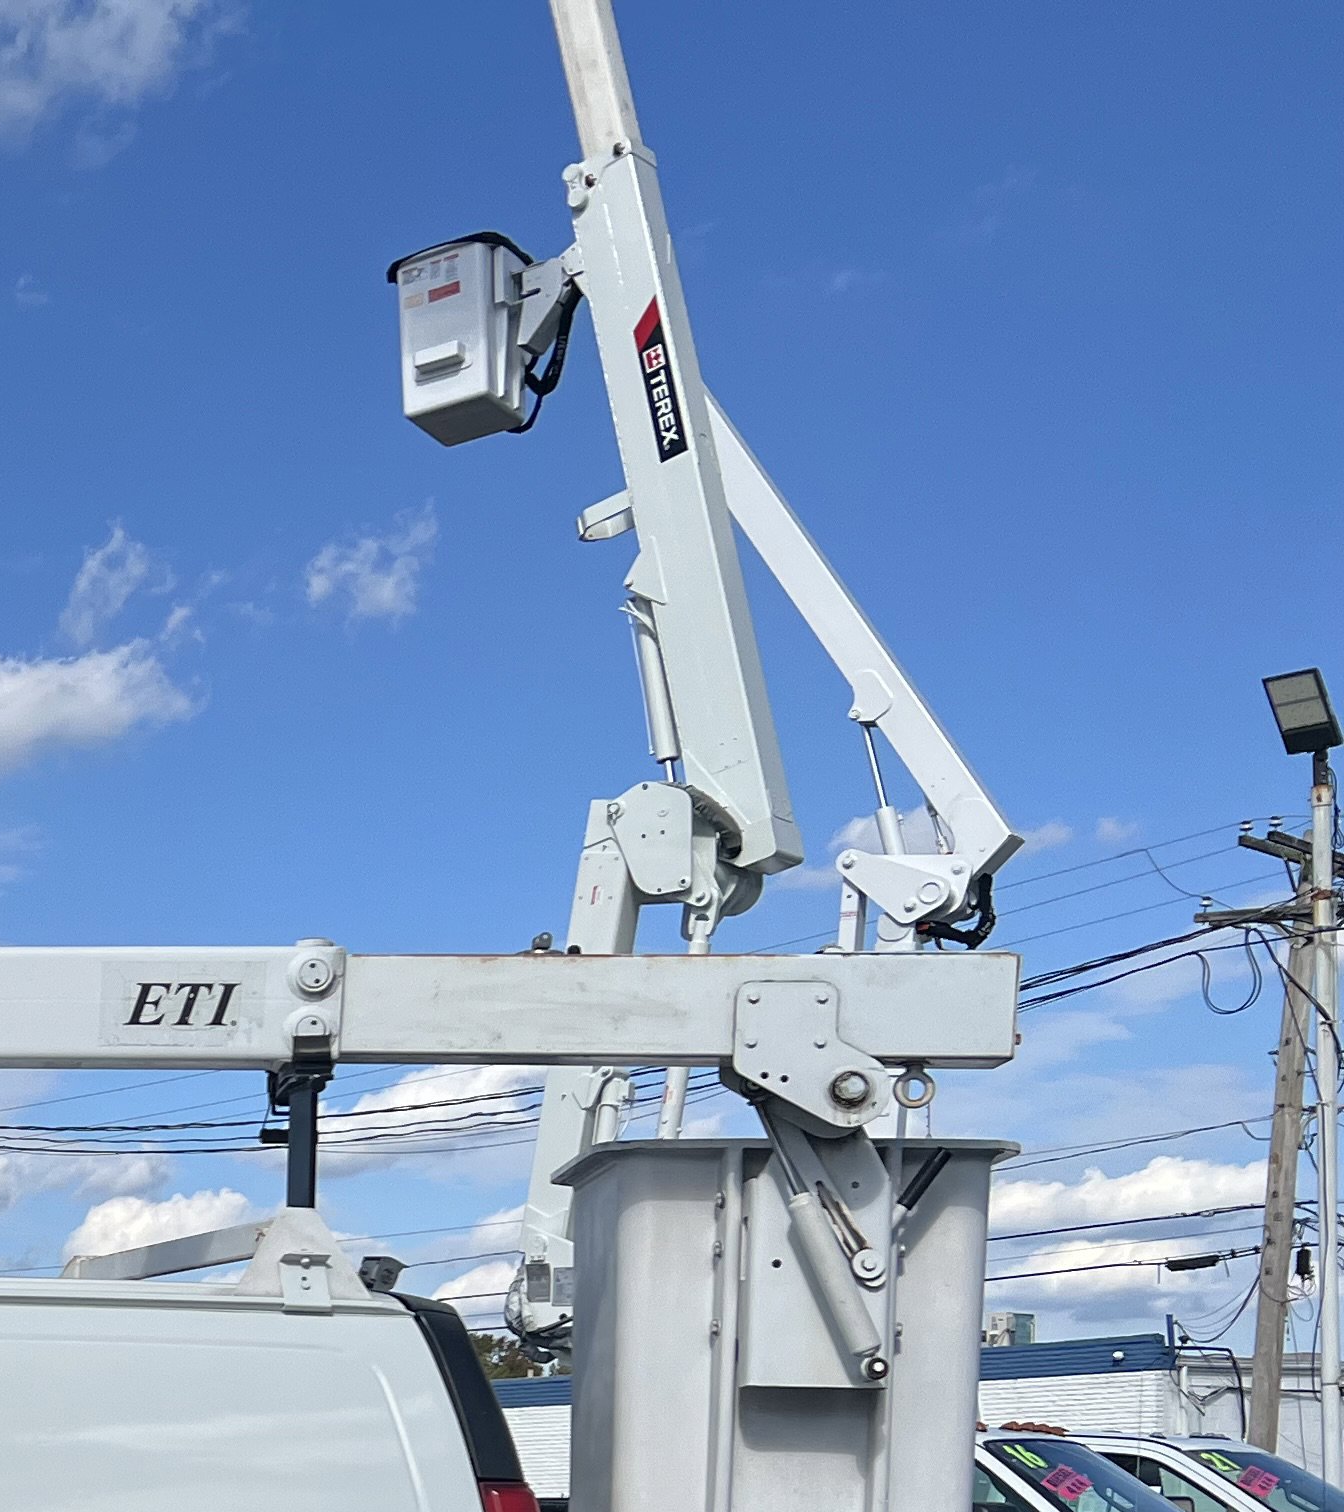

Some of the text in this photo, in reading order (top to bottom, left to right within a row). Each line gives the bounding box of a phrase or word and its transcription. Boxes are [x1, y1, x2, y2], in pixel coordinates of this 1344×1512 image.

[650, 369, 680, 446] TEREX
[123, 982, 242, 1026] ETI
[1002, 1444, 1048, 1469] 16
